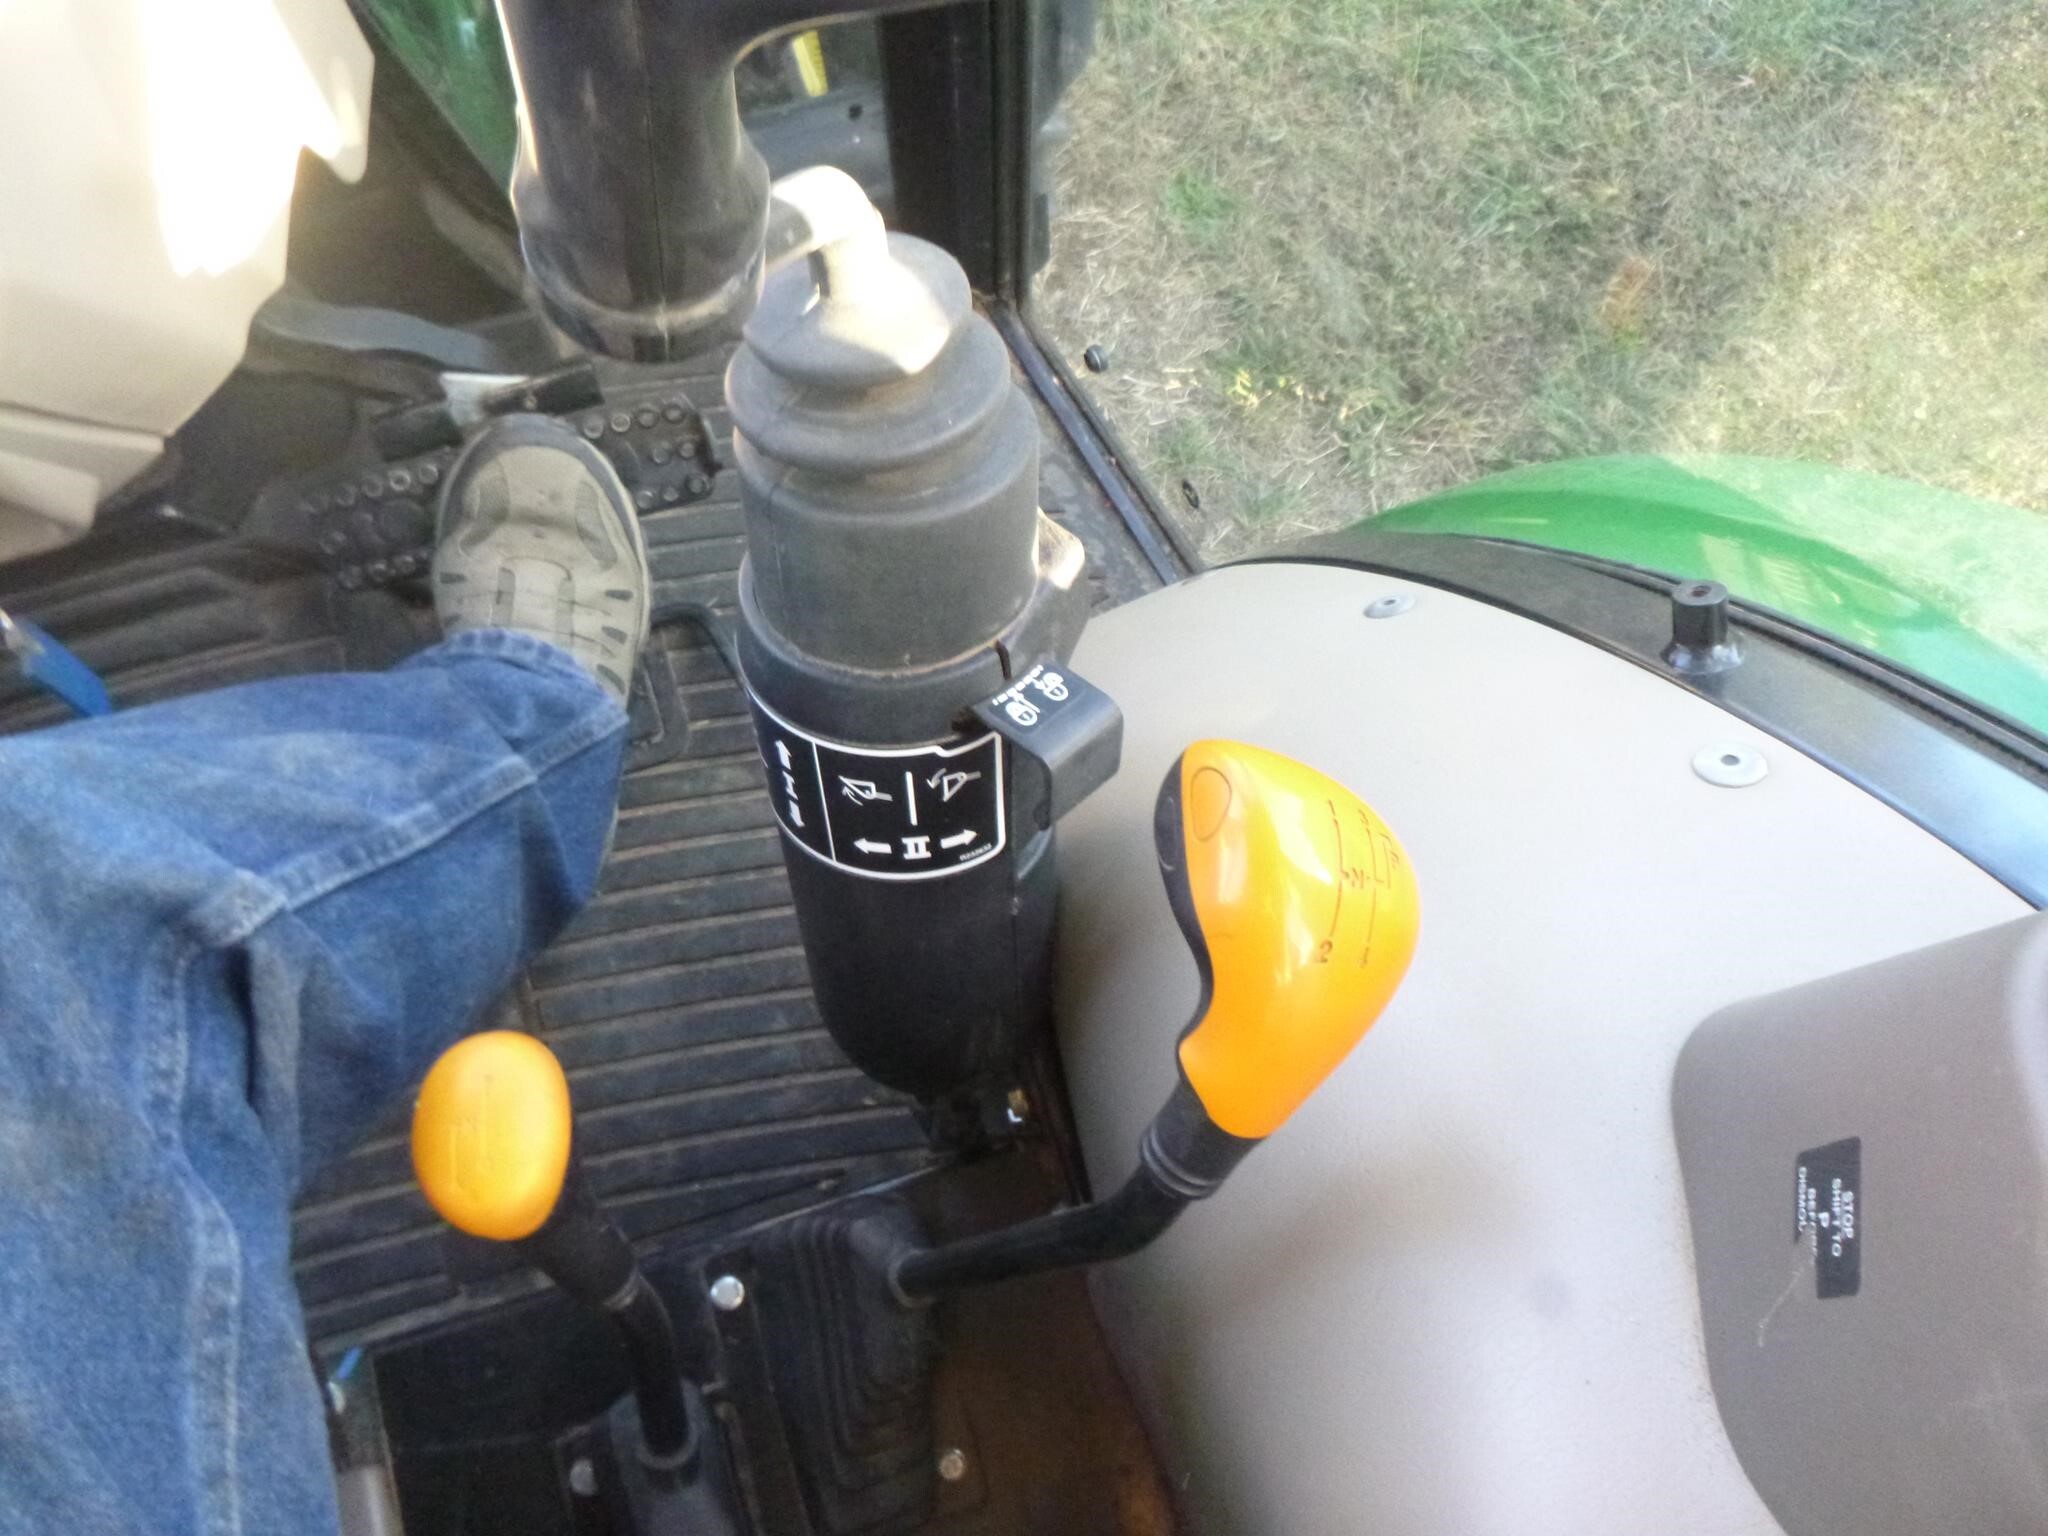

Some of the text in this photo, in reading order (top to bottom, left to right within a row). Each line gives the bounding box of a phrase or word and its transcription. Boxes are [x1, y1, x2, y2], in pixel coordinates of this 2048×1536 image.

[1313, 939, 1334, 963] 2
[1818, 1211, 1830, 1228] P
[1831, 1178, 1842, 1257] SHIFT TO
[1842, 1191, 1854, 1239] STOP
